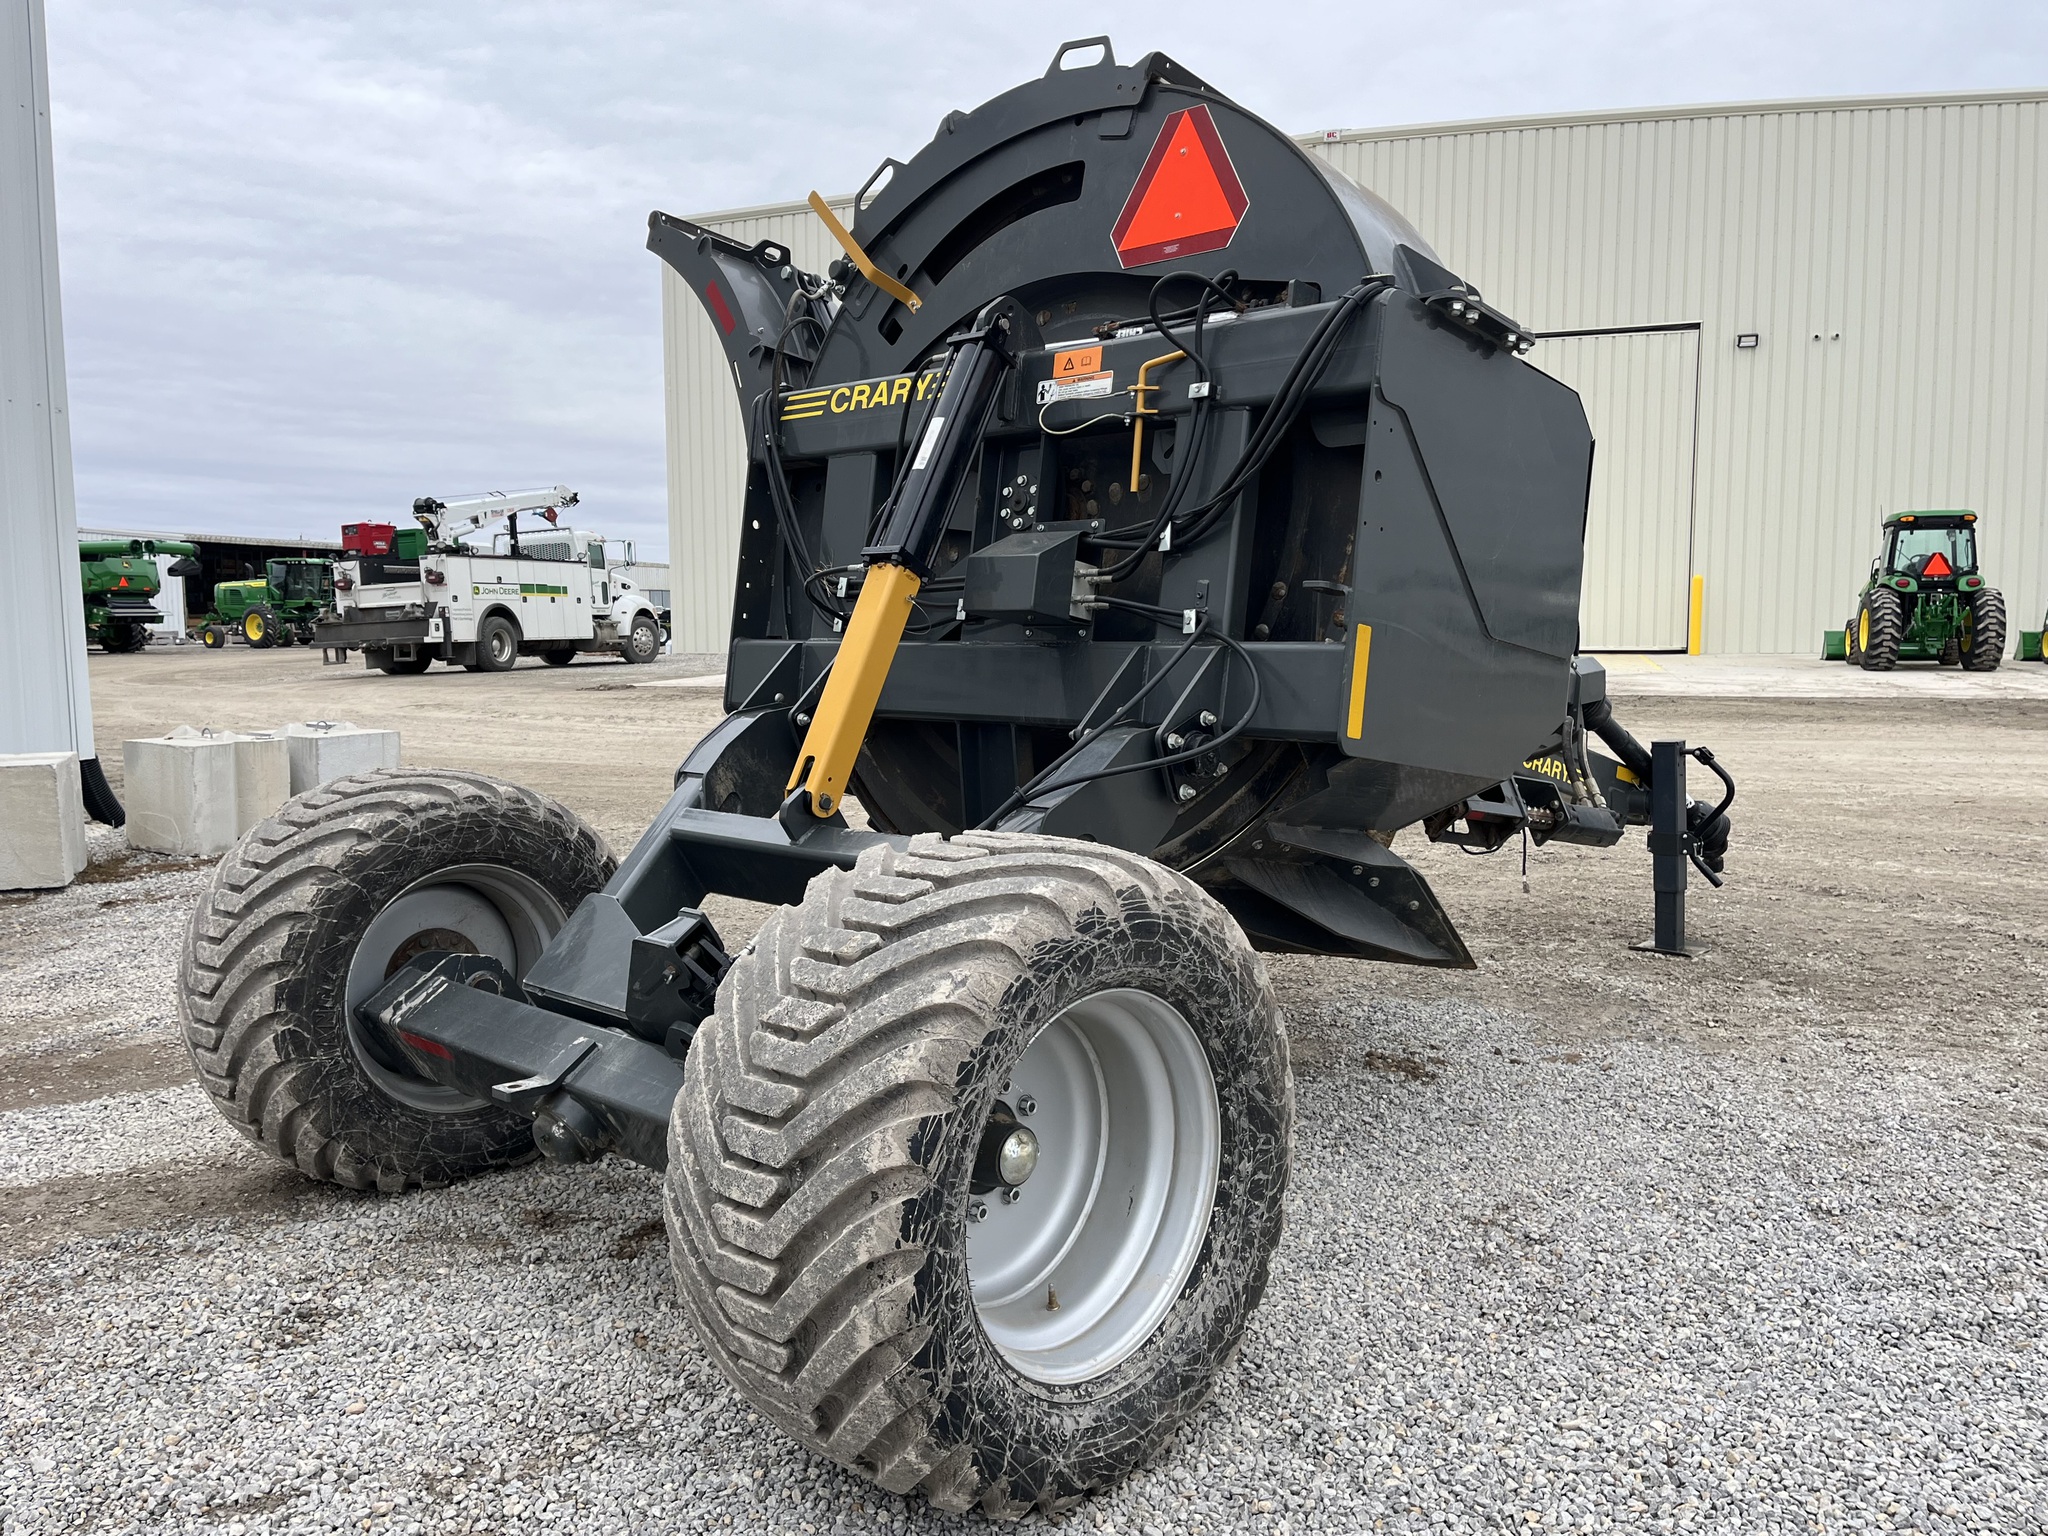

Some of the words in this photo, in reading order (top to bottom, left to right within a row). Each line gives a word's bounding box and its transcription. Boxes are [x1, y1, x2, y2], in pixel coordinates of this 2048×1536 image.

[1116, 326, 1144, 339] CHIEF
[830, 373, 934, 414] CRARY
[481, 586, 498, 595] JOHN
[499, 586, 520, 595] DEERE
